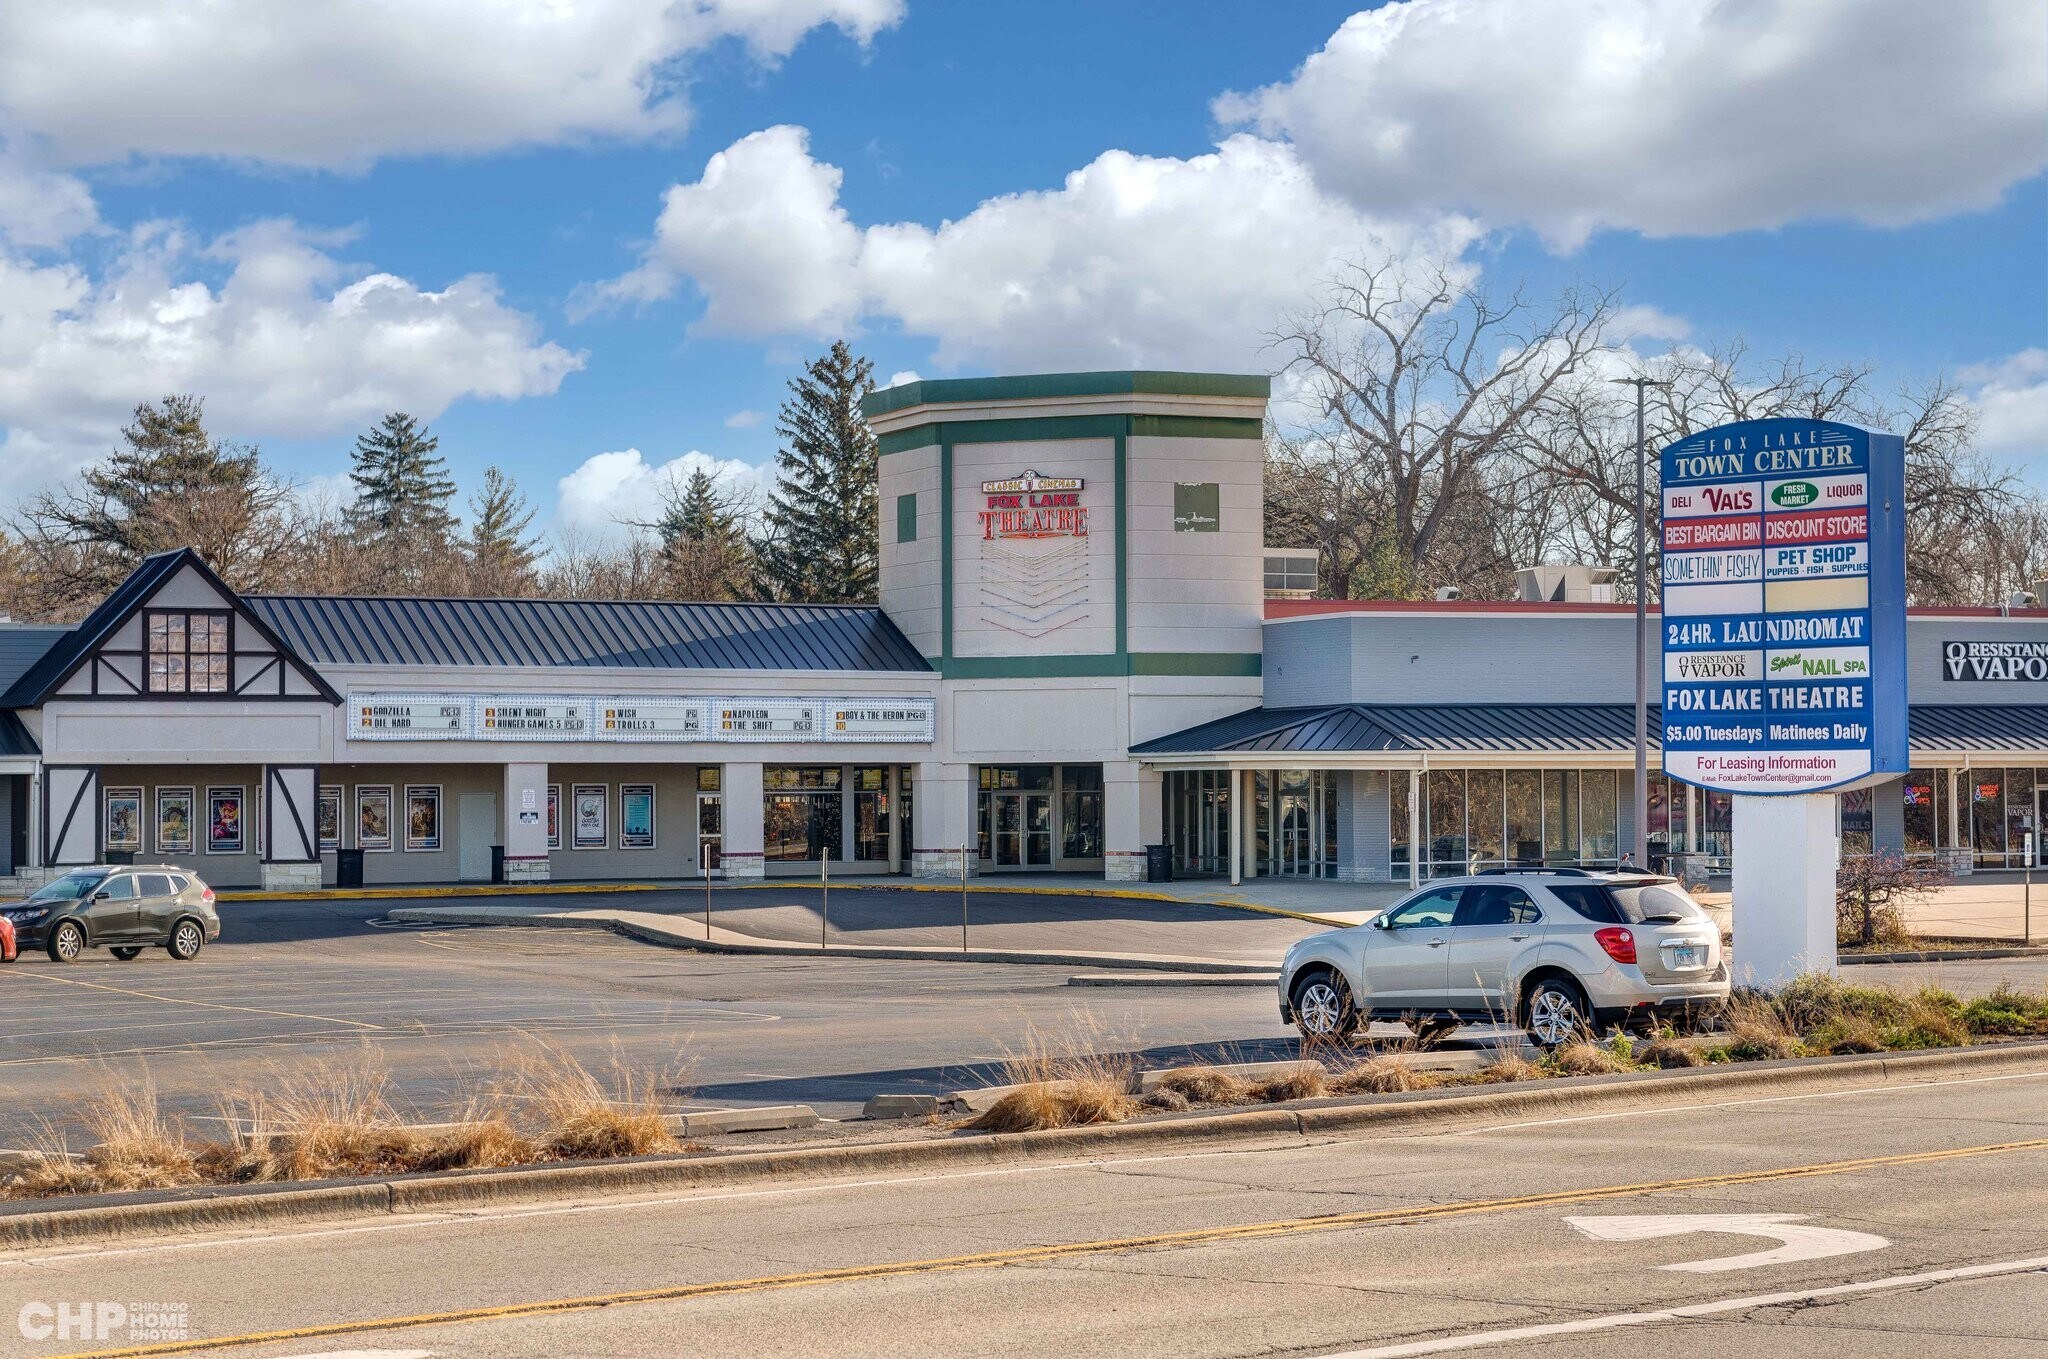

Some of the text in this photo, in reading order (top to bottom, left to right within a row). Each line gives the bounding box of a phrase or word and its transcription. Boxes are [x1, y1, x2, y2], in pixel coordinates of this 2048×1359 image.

[1710, 431, 1816, 452] FOX LAKE
[1675, 444, 1854, 477] TOWN CENTER
[986, 479, 1077, 491] CLASSIC CINEMAS
[1783, 484, 1806, 494] FRESH
[1827, 484, 1863, 498] LIQUOR
[987, 494, 1080, 509] FOX LAKE
[1672, 496, 1692, 508] DELI
[1780, 495, 1809, 506] MARKET
[978, 508, 1090, 540] THEATRE
[1665, 515, 1867, 545] BEST BARGAIN BIN DISCOUNT STORE
[1778, 546, 1857, 565] PET SHOP
[1665, 554, 1760, 580] SOMETHIN' FISHY
[1767, 562, 1868, 576] PUPPIES FISH SUPPLIES
[1723, 616, 1863, 643] LAUNDROMAT
[1690, 655, 1746, 664] RESISTANCE
[1691, 663, 1746, 678] VAPOR
[1802, 659, 1841, 675] NAIL
[1844, 660, 1867, 672] SPA
[1967, 657, 2048, 680] VAPO
[1667, 686, 1863, 710] FOX LAKE THEATRE
[373, 707, 411, 716] GODZILLA
[498, 708, 522, 717] SILENT
[526, 708, 547, 717] NIGHT
[618, 709, 637, 718] WISH
[733, 710, 768, 719] NAPOLEON
[846, 711, 858, 719] BOY
[860, 711, 865, 719] &
[867, 711, 879, 719] THE
[883, 711, 904, 720] HERON
[374, 719, 387, 728] DIE
[392, 719, 411, 728] HARD
[498, 720, 526, 728] HUNGER
[528, 720, 553, 729] GAMES
[557, 720, 561, 729] 5
[617, 720, 647, 729] TROLLS
[650, 720, 655, 729] 3
[733, 721, 746, 730] THE
[753, 721, 773, 730] SHIFT
[837, 722, 845, 730] 10
[1666, 723, 1867, 744] $5.00 Tuesdays Matinees Daily
[1697, 755, 1836, 772] For Leasing Information
[1718, 774, 1832, 784] FoxLakeTownCenter@gmail.com
[1842, 821, 1870, 830] NAILS
